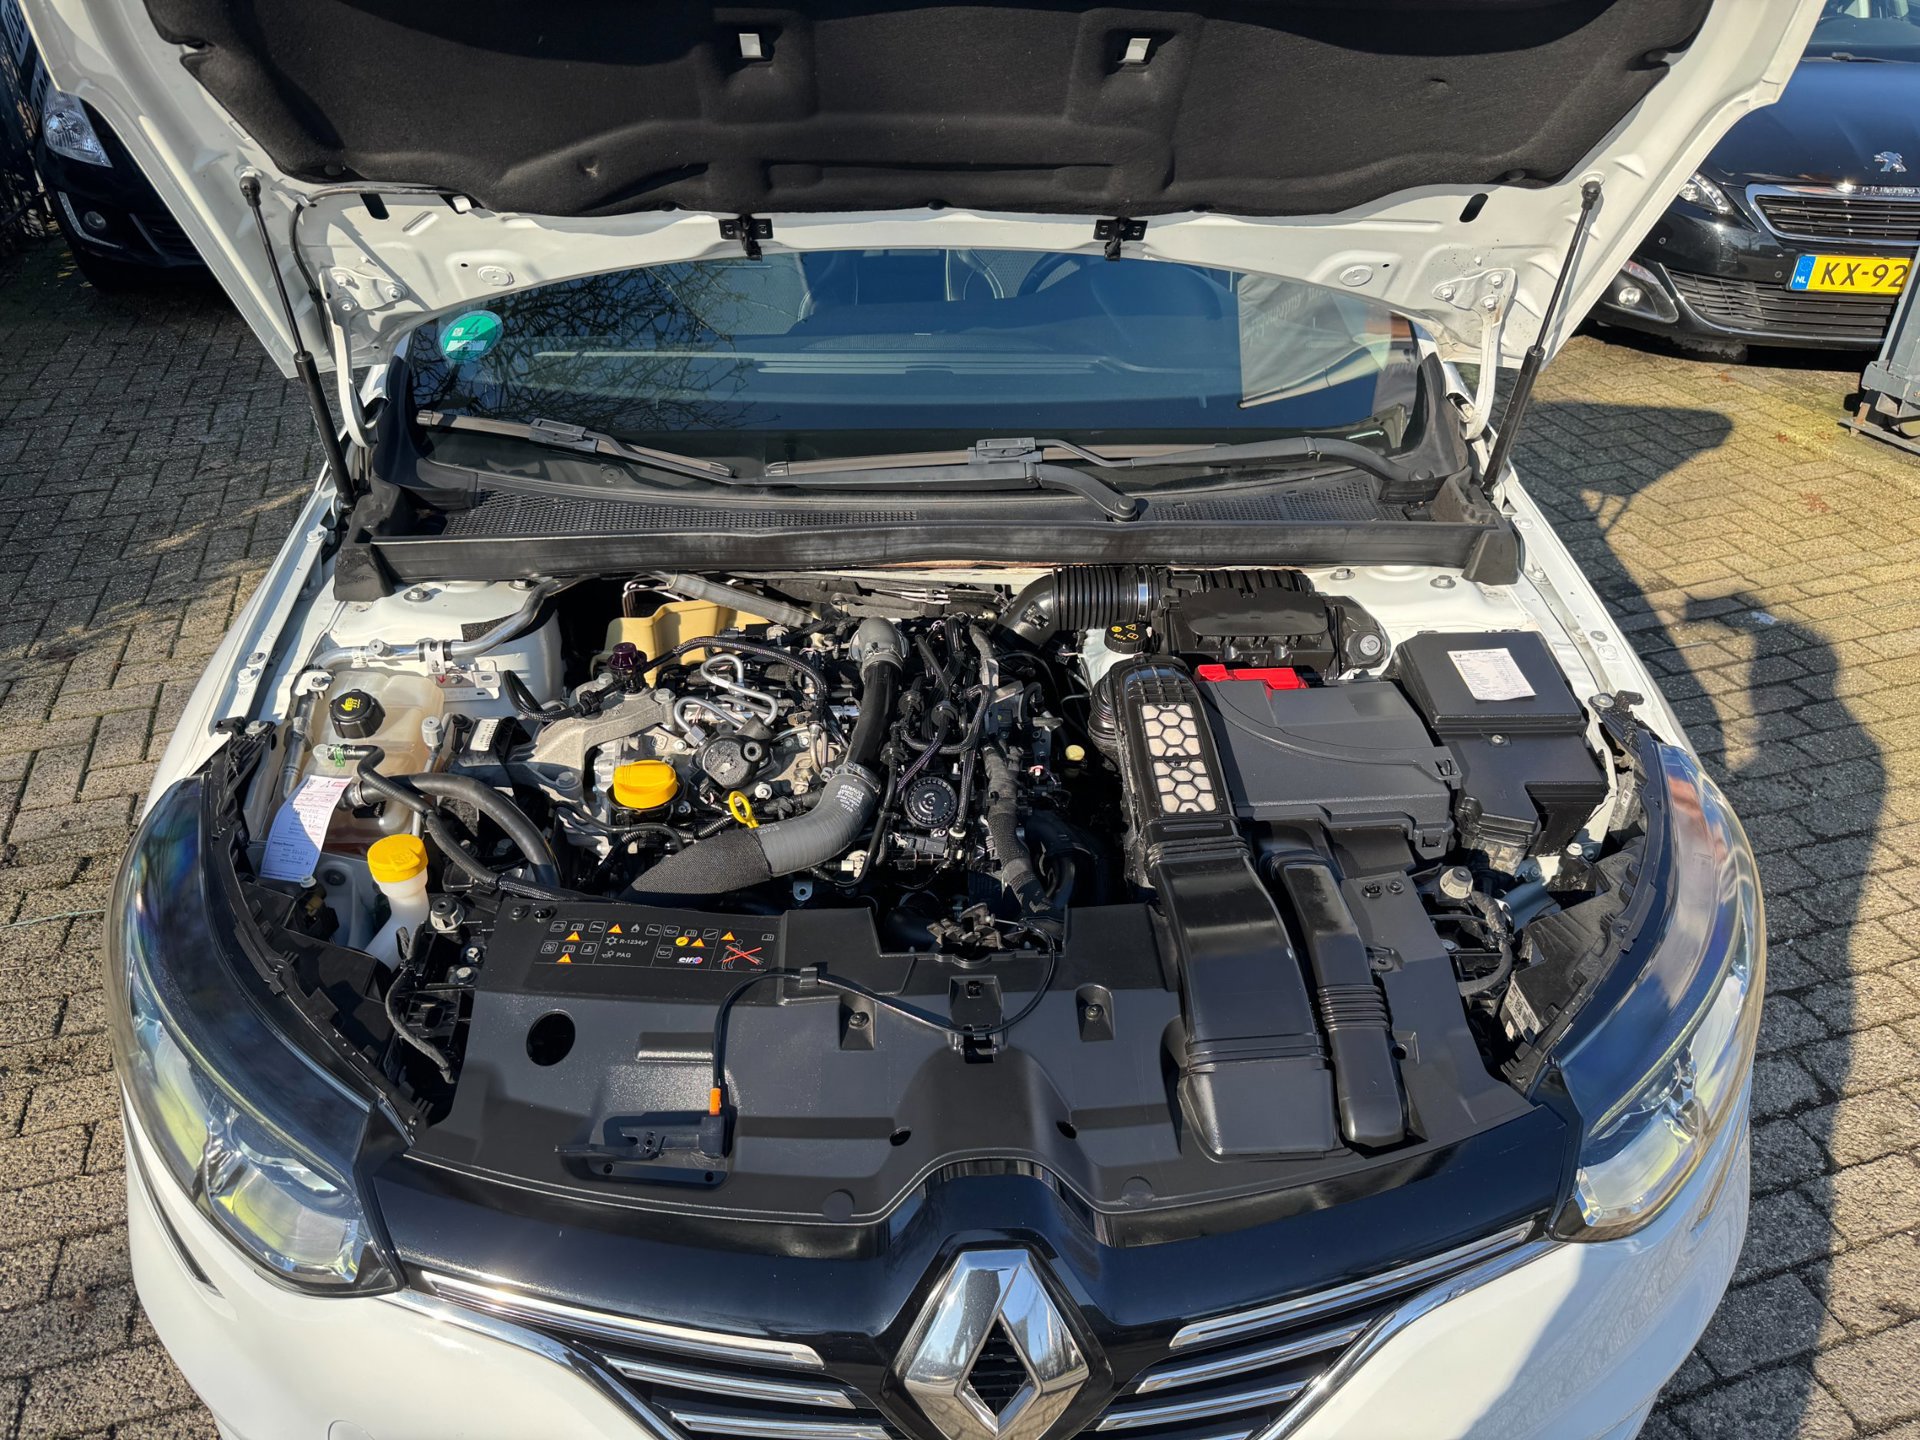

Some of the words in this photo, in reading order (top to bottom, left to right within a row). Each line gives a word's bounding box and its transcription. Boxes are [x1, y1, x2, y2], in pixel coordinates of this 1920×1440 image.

[1795, 275, 1807, 284] NL
[1820, 262, 1908, 288] KX-92
[464, 318, 481, 335] 4
[619, 938, 649, 946] R-1234yf
[678, 956, 695, 964] elf
